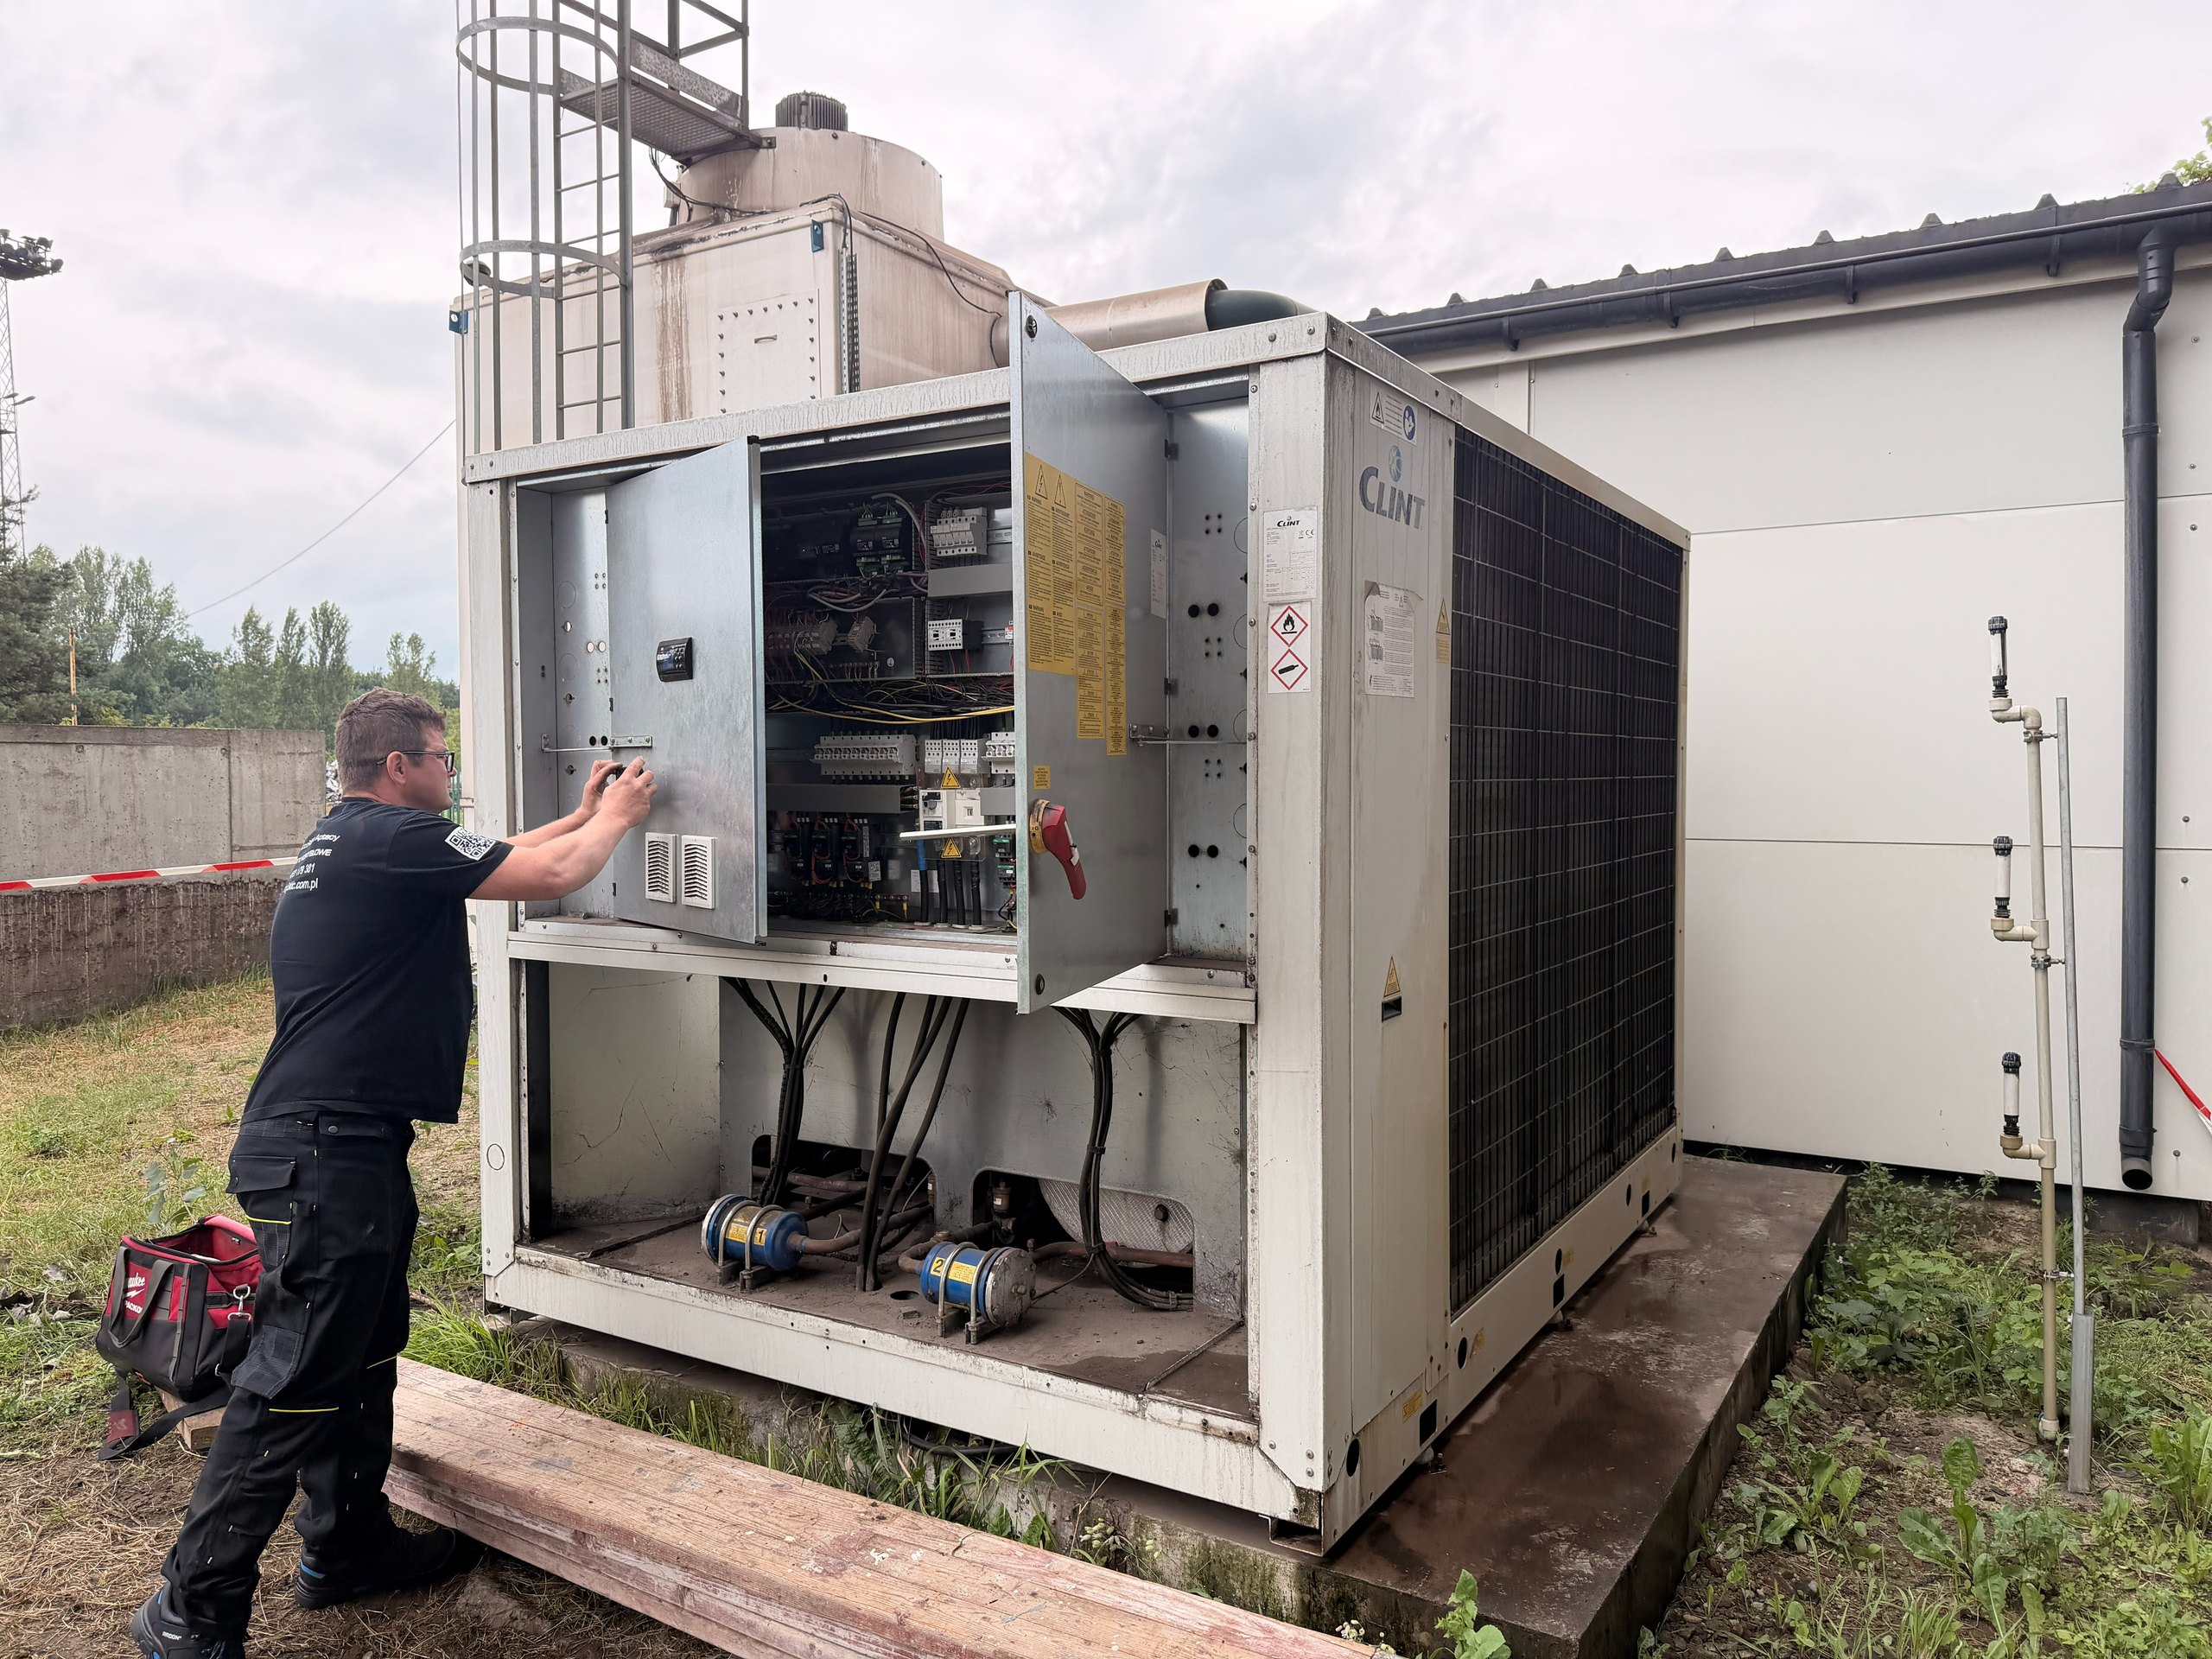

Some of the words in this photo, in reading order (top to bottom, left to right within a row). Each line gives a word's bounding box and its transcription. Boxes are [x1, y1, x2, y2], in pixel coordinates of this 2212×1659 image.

[1359, 466, 1426, 530] CLINT
[759, 1230, 764, 1243] 1
[932, 1259, 944, 1273] 2
